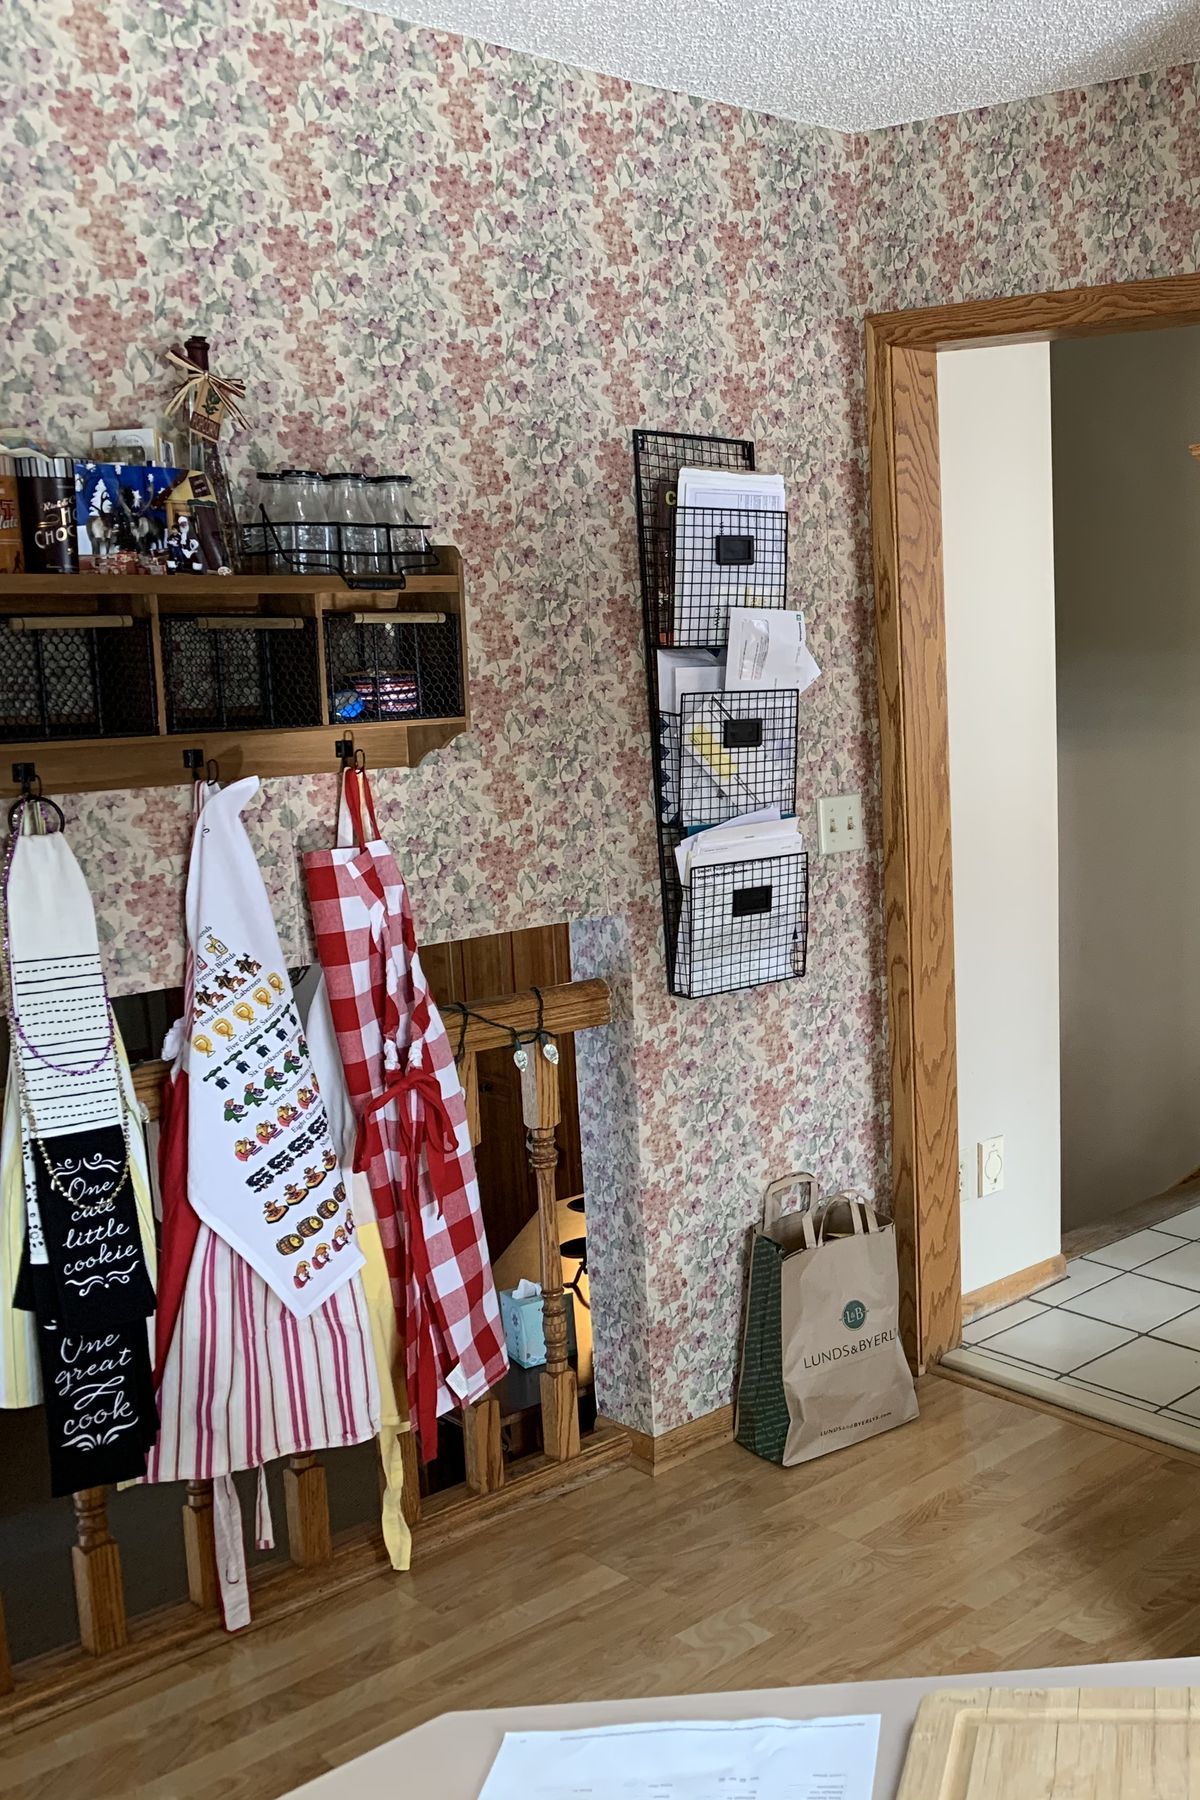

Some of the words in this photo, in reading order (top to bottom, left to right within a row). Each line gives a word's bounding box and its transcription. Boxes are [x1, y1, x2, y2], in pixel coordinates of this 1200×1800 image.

[196, 966, 216, 985] French
[215, 952, 236, 970] Blends
[199, 1013, 215, 1027] Four
[213, 998, 235, 1016] Hearty
[225, 1040, 239, 1053] Five
[238, 1023, 261, 1042] Golden
[248, 1068, 259, 1078] Six
[258, 1043, 289, 1070] Corkscrews
[269, 1091, 286, 1107] Seven
[291, 1119, 304, 1133] Eight
[68, 1177, 115, 1202] One
[71, 1197, 116, 1222] cute
[62, 1218, 130, 1249] little
[63, 1243, 138, 1275] cookie
[60, 1334, 120, 1363] One
[54, 1347, 132, 1396] great
[63, 1390, 134, 1435] cook
[820, 1411, 892, 1437] LUNDSandBYERLYS.com
